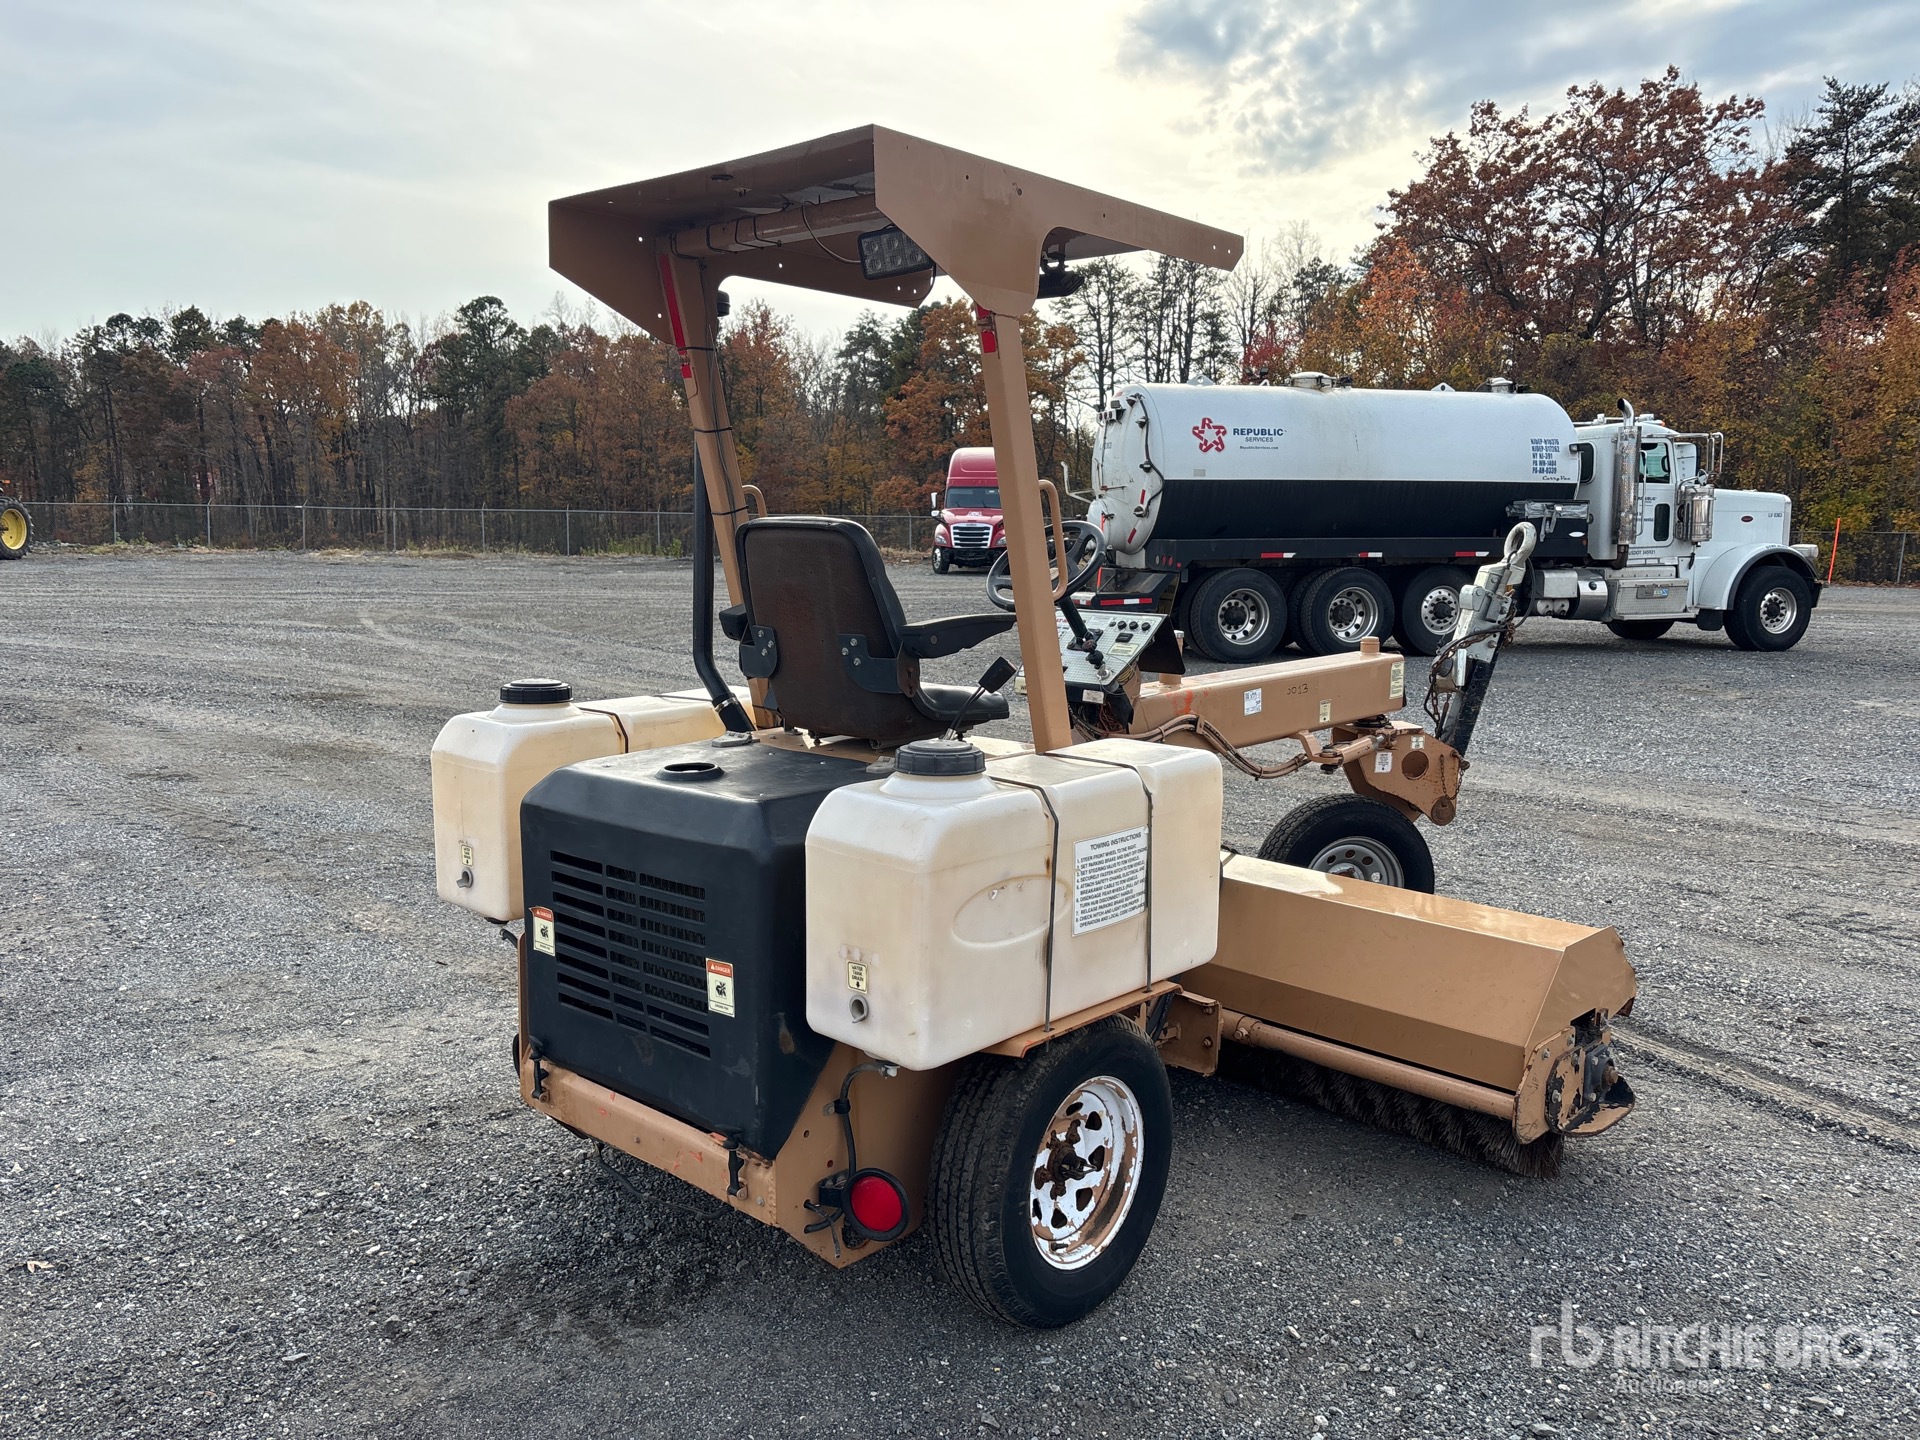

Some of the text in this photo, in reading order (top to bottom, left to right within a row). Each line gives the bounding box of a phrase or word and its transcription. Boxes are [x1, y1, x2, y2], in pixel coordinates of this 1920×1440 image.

[1233, 428, 1283, 436] REPUBLIC
[1090, 832, 1142, 850] TOWING INSTRUCTIONS
[715, 965, 731, 973] DANGER
